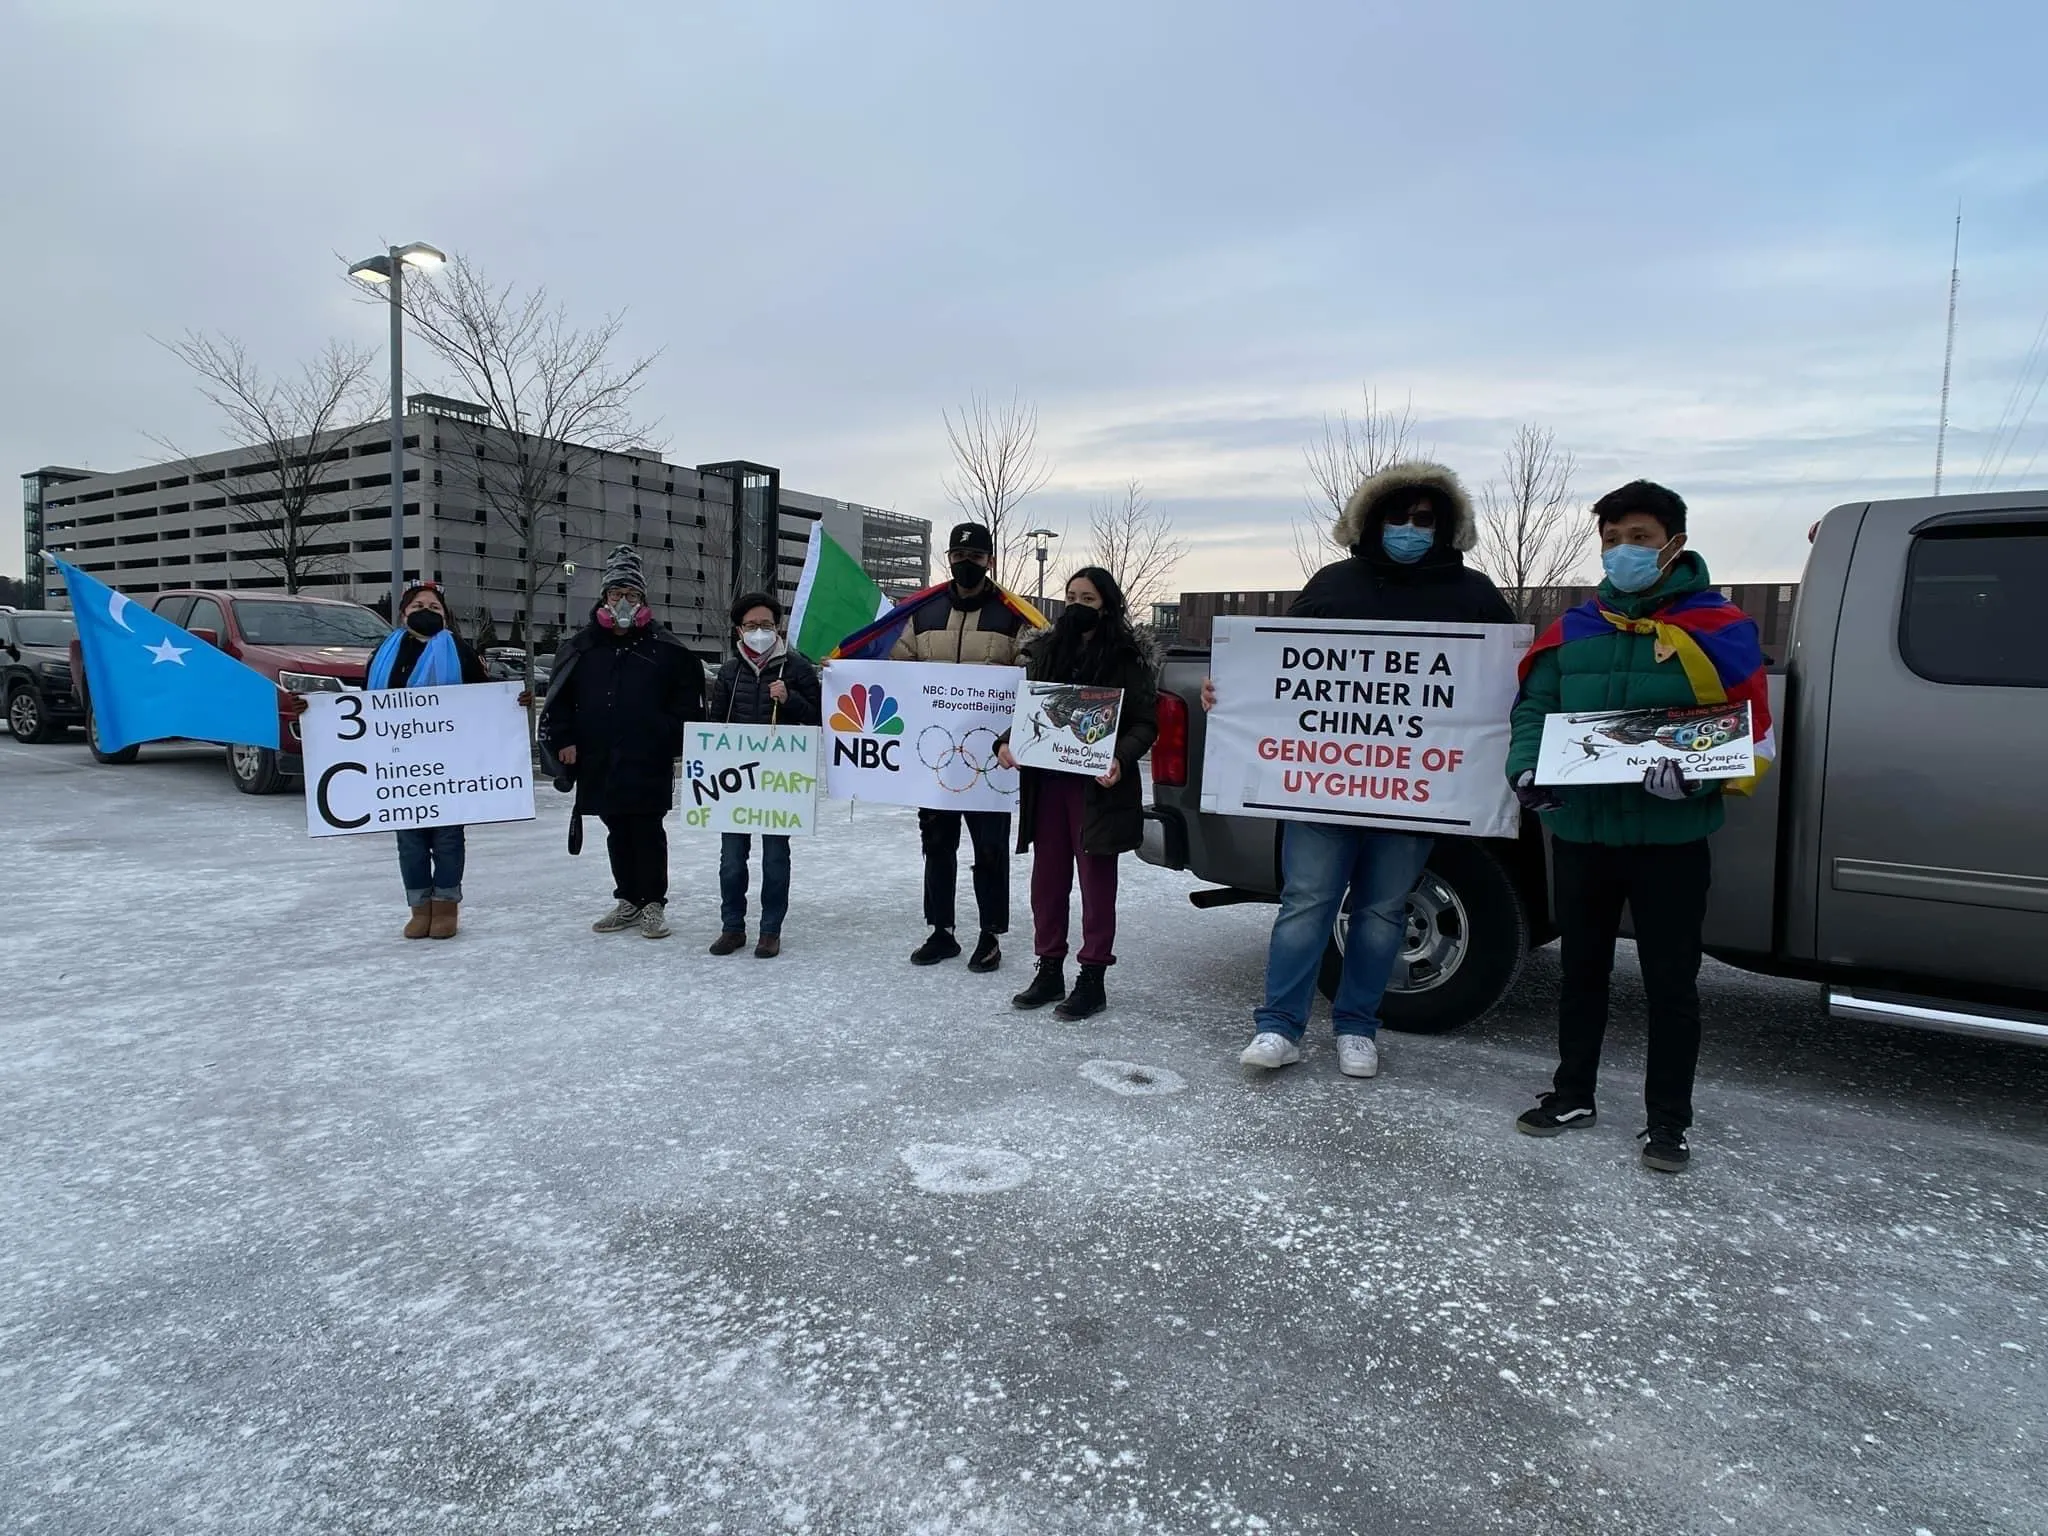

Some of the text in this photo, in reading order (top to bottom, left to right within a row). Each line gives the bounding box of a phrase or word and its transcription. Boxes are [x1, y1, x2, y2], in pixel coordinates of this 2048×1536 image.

[1281, 647, 1452, 677] DON'T BE A
[922, 685, 1016, 701] NBC: Do The Right
[1274, 678, 1455, 708] PARTNER IN
[334, 691, 439, 741] 3 Million
[1298, 710, 1424, 739] CHINA'S
[374, 718, 455, 740] Uyghurs
[392, 745, 400, 753] in
[697, 732, 807, 753] TAIWAN
[833, 737, 900, 772] NBC
[1052, 742, 1063, 753] No
[1257, 737, 1464, 773] GENOCIDE OF
[1627, 756, 1647, 766] No
[1686, 752, 1750, 765] Olympic
[375, 761, 445, 780] hinese
[1695, 763, 1746, 773] Games
[316, 761, 371, 829] C
[376, 774, 523, 800] oncentration
[692, 761, 760, 806] NOT
[761, 770, 816, 794] PART
[1282, 771, 1430, 803] UYGHURS
[378, 803, 440, 824] amps
[686, 807, 802, 829] OF CHINA
